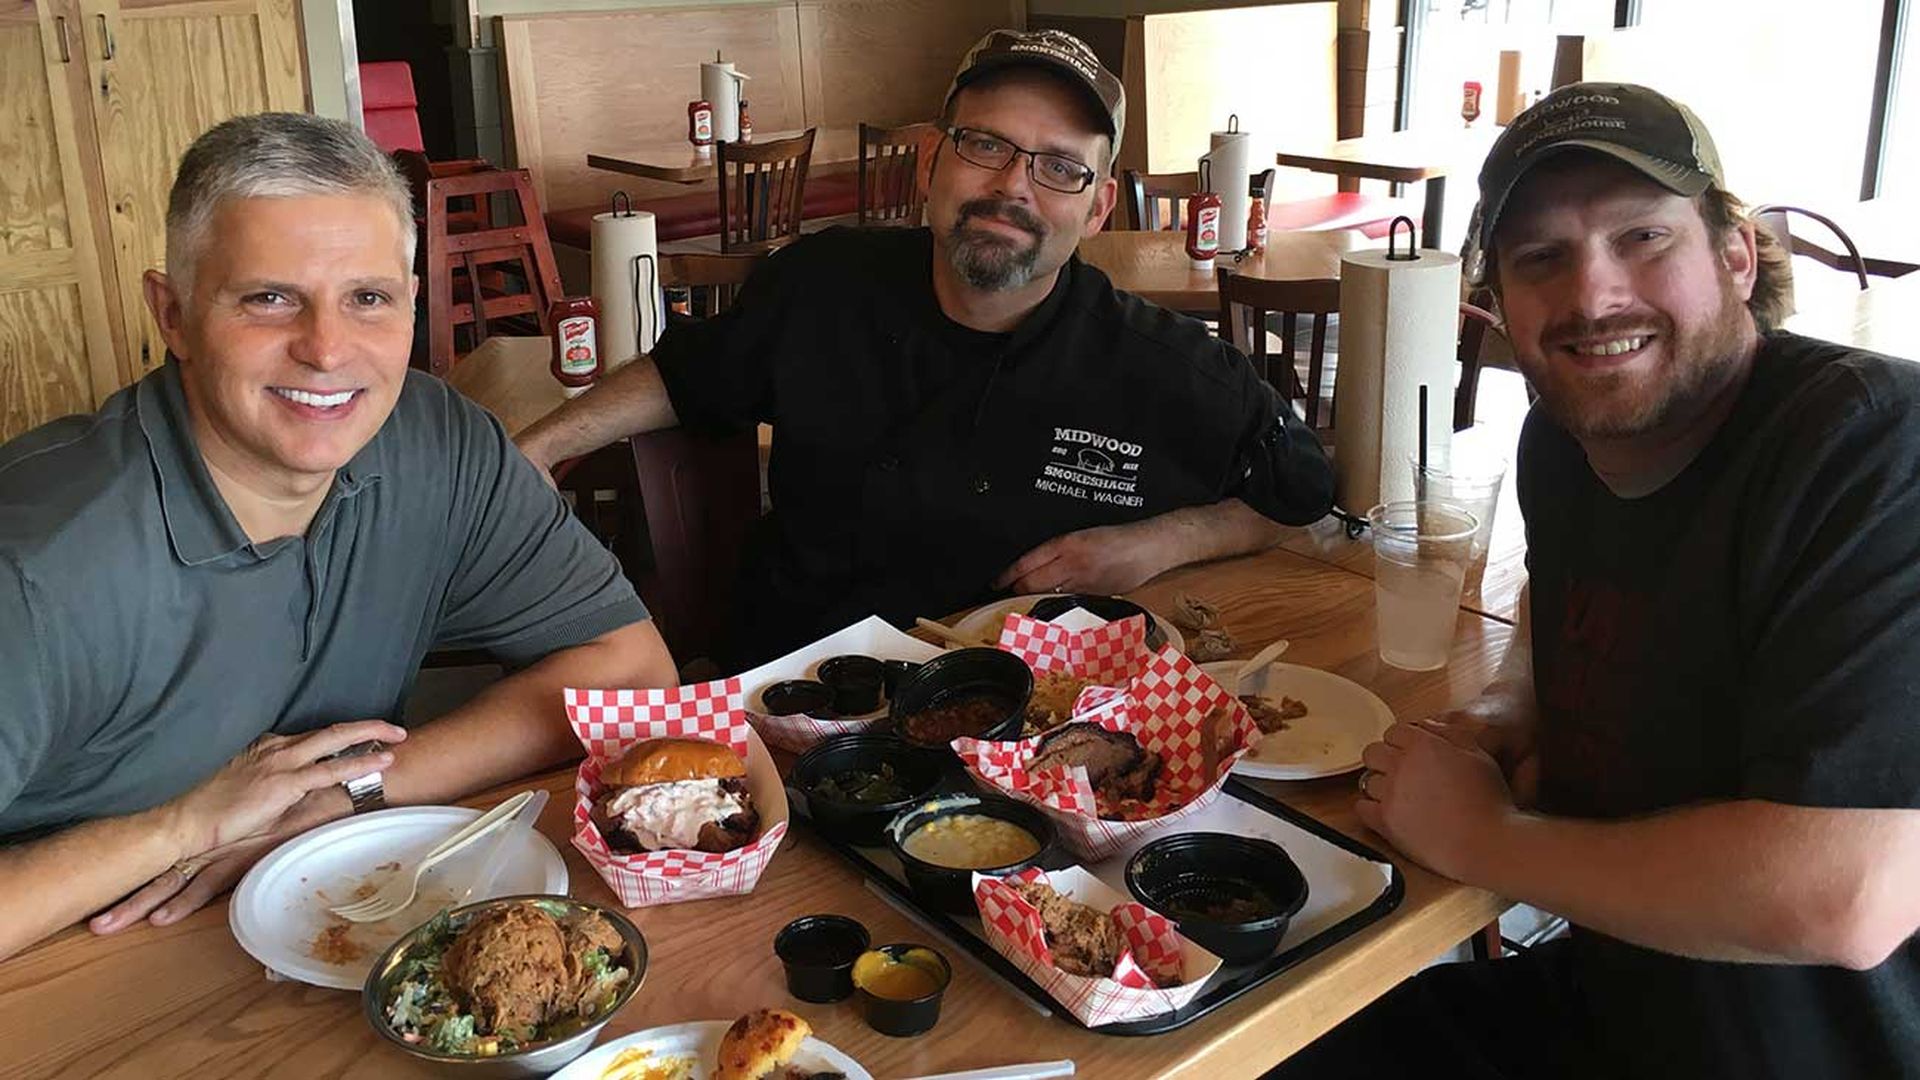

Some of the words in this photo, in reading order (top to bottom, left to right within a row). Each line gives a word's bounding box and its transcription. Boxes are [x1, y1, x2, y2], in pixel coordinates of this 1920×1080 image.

[1053, 427, 1143, 457] MIDWOOD
[1035, 478, 1088, 499] MICHAEL
[1093, 491, 1144, 507] WAGNER
[1044, 465, 1137, 493] SMOKESHACK
